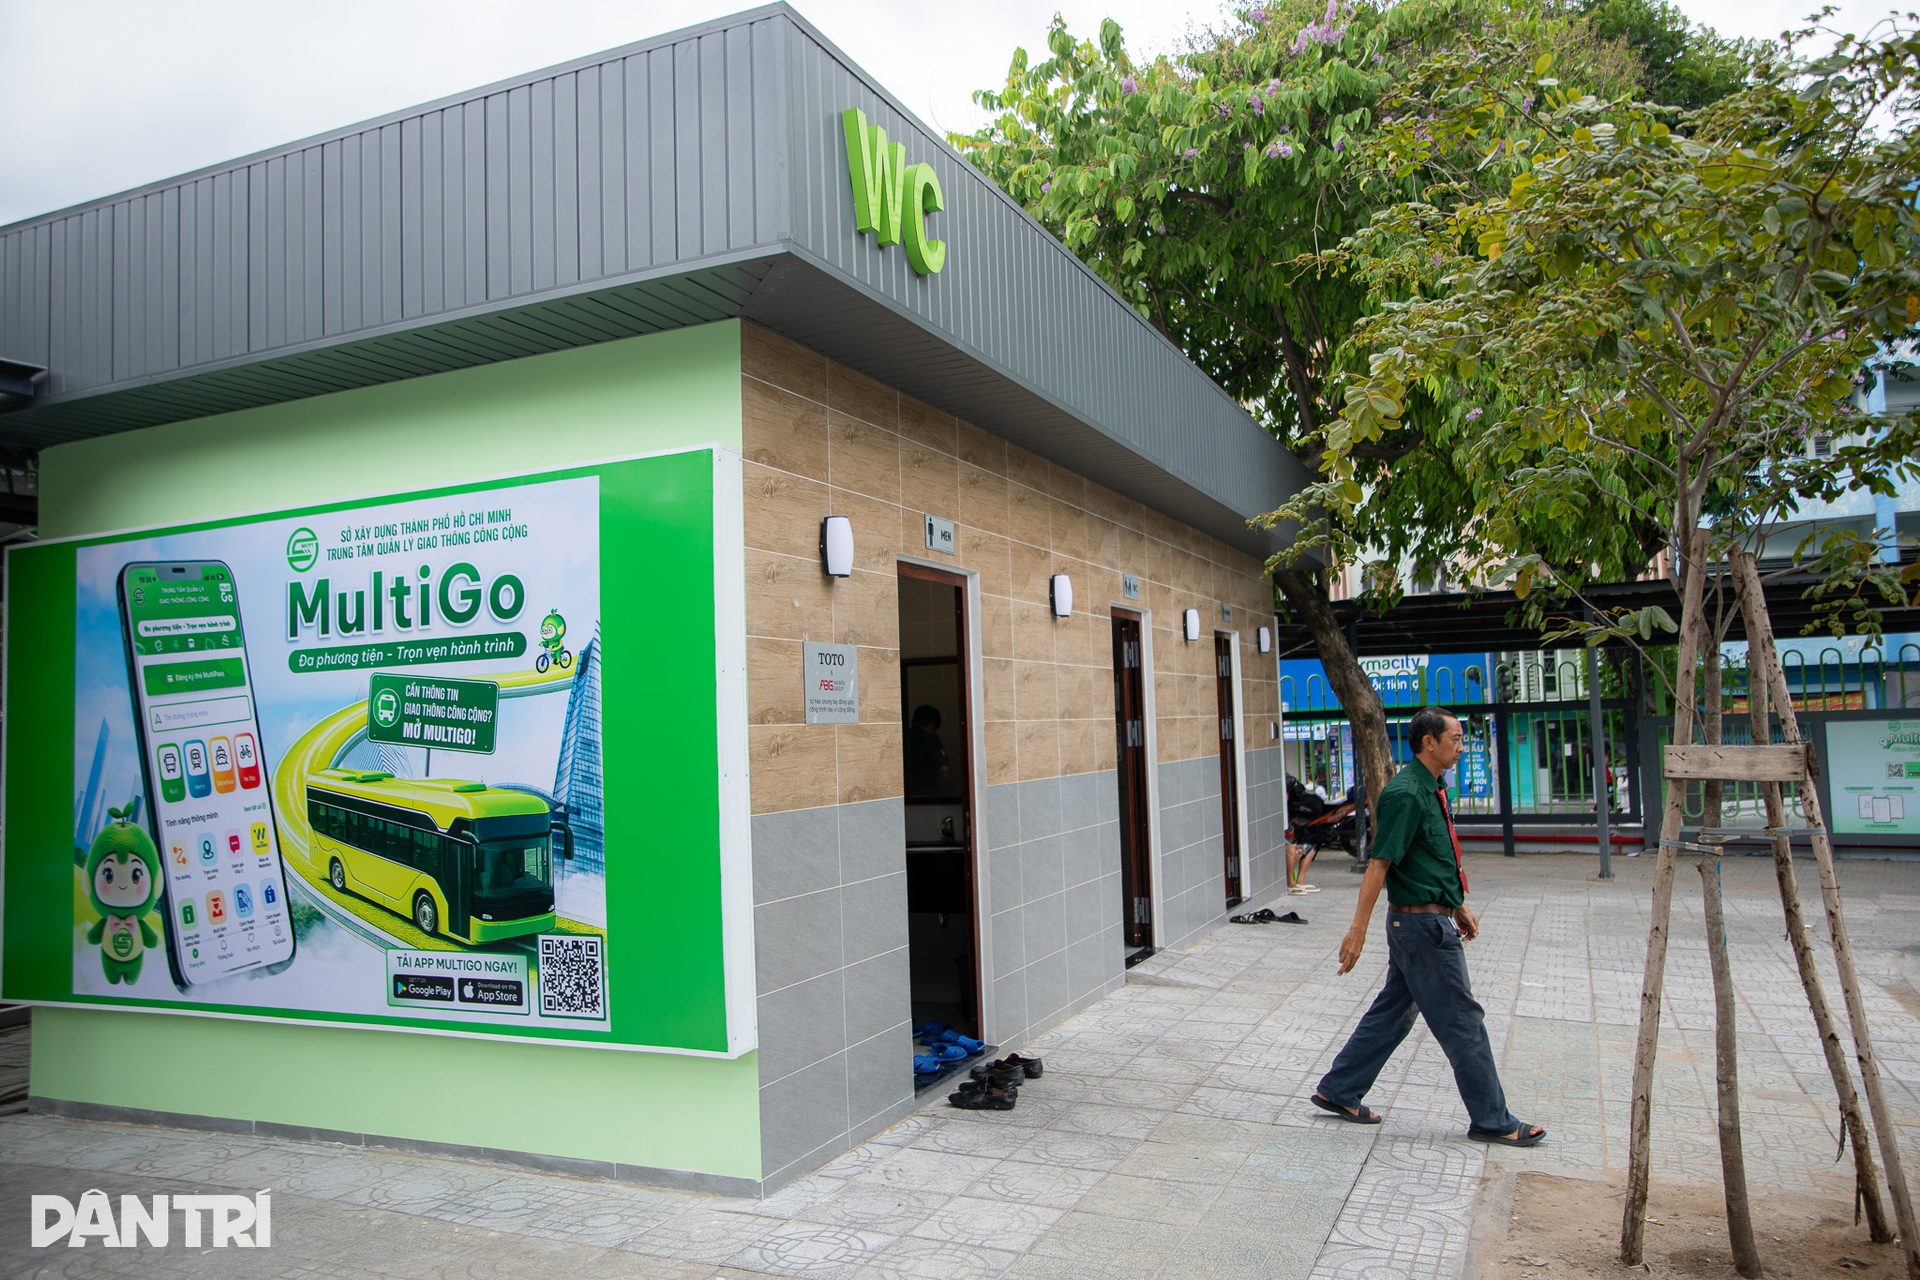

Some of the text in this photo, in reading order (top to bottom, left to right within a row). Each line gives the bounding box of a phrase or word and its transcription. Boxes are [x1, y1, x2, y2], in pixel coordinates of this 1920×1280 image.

[842, 107, 946, 275] WC
[354, 526, 371, 541] XÂY
[374, 524, 397, 540] DỰNG
[400, 518, 429, 535] THÀNH
[432, 512, 450, 530] PHỐ
[453, 510, 465, 528] HỒ
[469, 509, 484, 526] CHÍ
[487, 508, 511, 523] MINH
[327, 524, 528, 561] TRUNG TÂM QUẢN LÝ GIAO THÔNG CÔNG CỘNG
[940, 529, 951, 542] MEN
[288, 561, 526, 639] MultiGo
[299, 654, 314, 667] Đa
[316, 652, 359, 669] phương
[361, 648, 383, 665] tiện
[397, 646, 423, 662] Trọn
[426, 646, 447, 660] vẹn
[450, 640, 481, 655] hành
[484, 638, 514, 653] trình
[818, 652, 844, 666] TOTO
[1360, 655, 1420, 671] rmacity
[421, 684, 445, 700] THÔNG
[446, 688, 459, 701] TIN
[404, 702, 493, 723] GIAO THÔNG CÔNG CỘNG?
[402, 718, 476, 745] MỞ MULTIGO!
[396, 953, 518, 973] TẢI APP MULTIGO NGAY!
[408, 983, 452, 998] Google Play
[477, 990, 518, 1002] App Store
